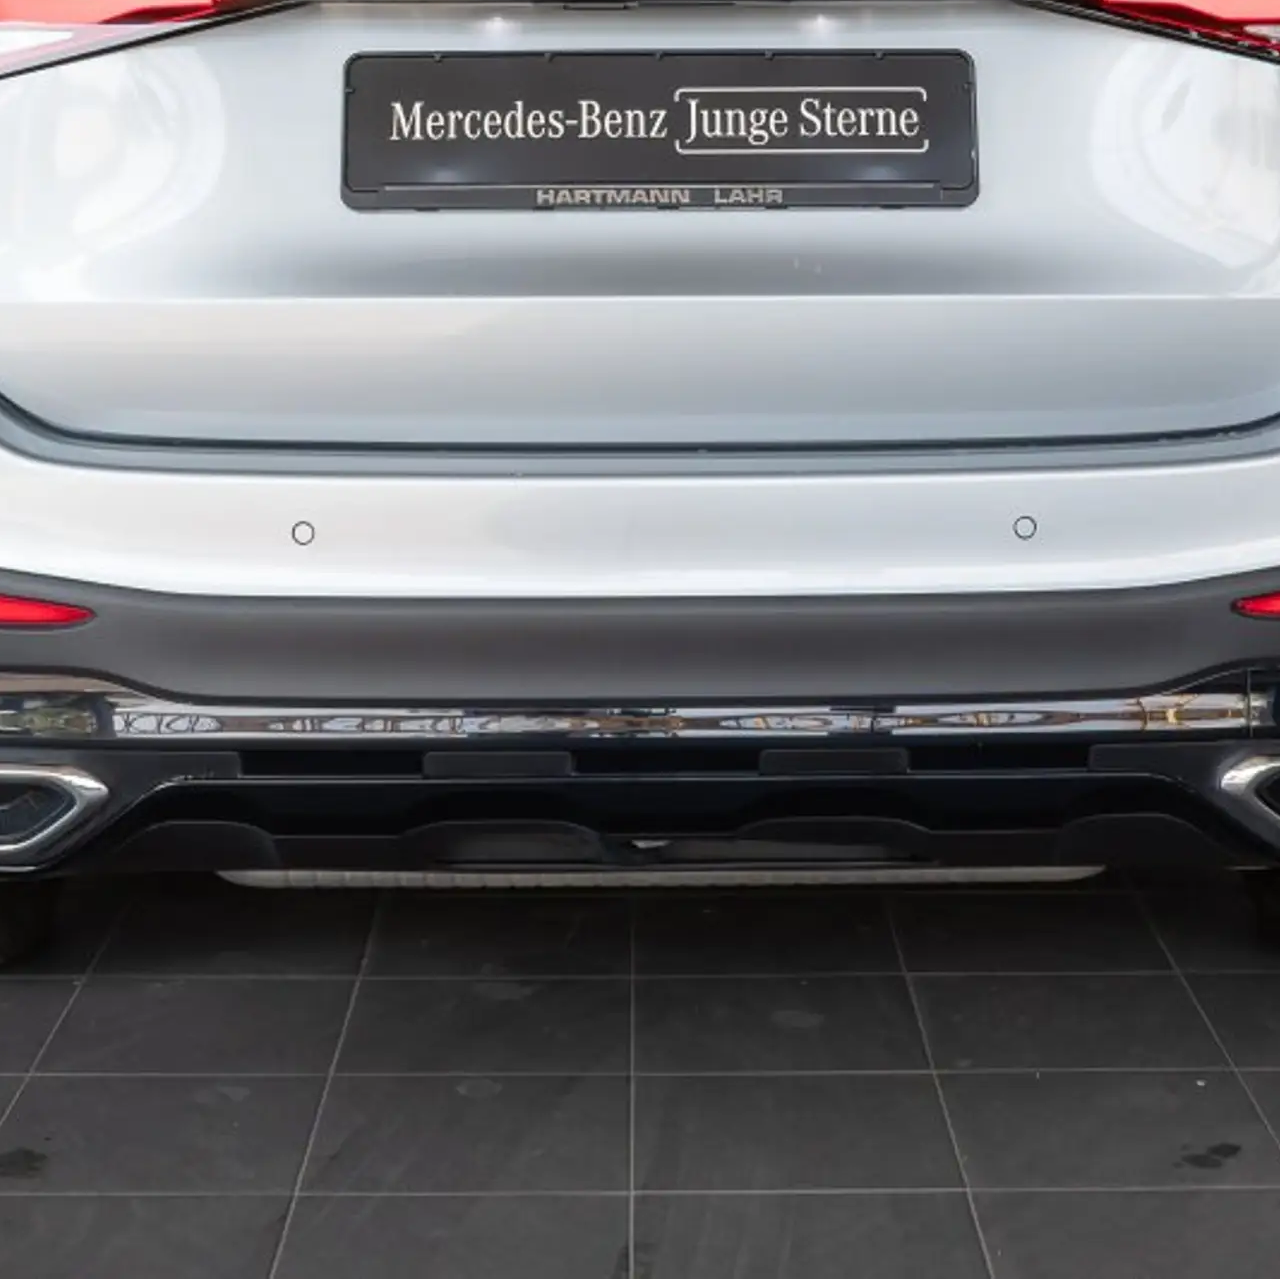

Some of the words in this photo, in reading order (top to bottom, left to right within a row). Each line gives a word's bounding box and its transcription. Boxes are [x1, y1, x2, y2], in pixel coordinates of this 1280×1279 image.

[389, 100, 668, 141] Mercedes-Benz
[685, 98, 789, 146] Junge
[799, 97, 920, 138] Sterne
[536, 187, 690, 206] HARTMANN
[713, 187, 784, 205] LAHR
